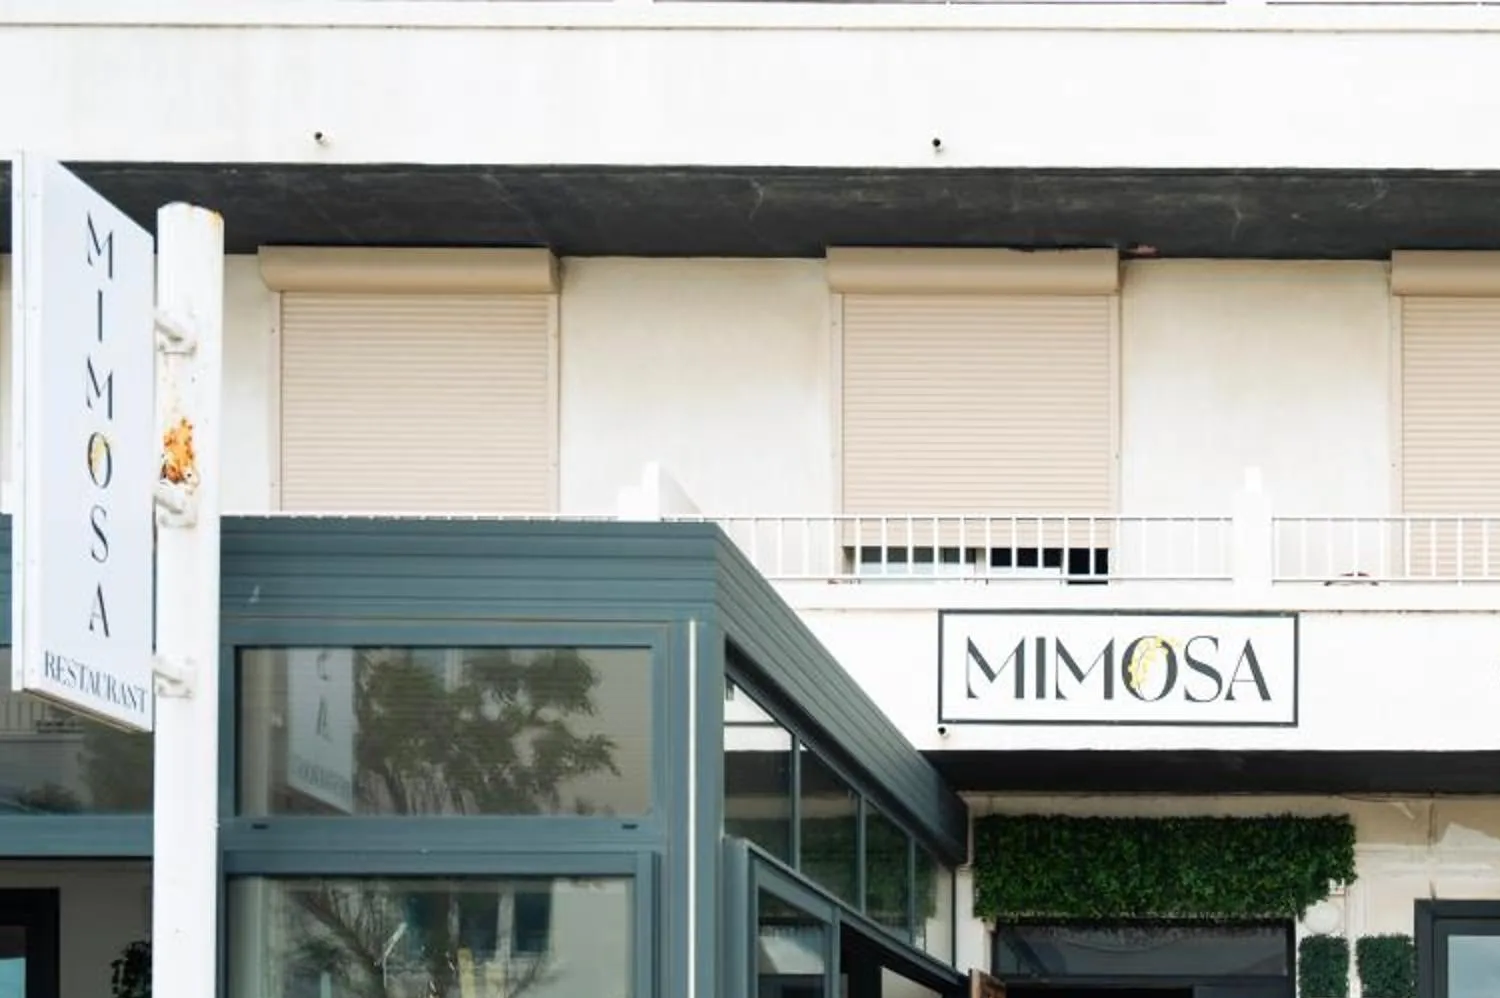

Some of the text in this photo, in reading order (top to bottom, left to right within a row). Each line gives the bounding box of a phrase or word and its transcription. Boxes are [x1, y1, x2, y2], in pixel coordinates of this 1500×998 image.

[86, 211, 114, 638] MIMOSA
[44, 650, 147, 714] RESTAURANT
[966, 635, 1273, 702] MIMOSA
